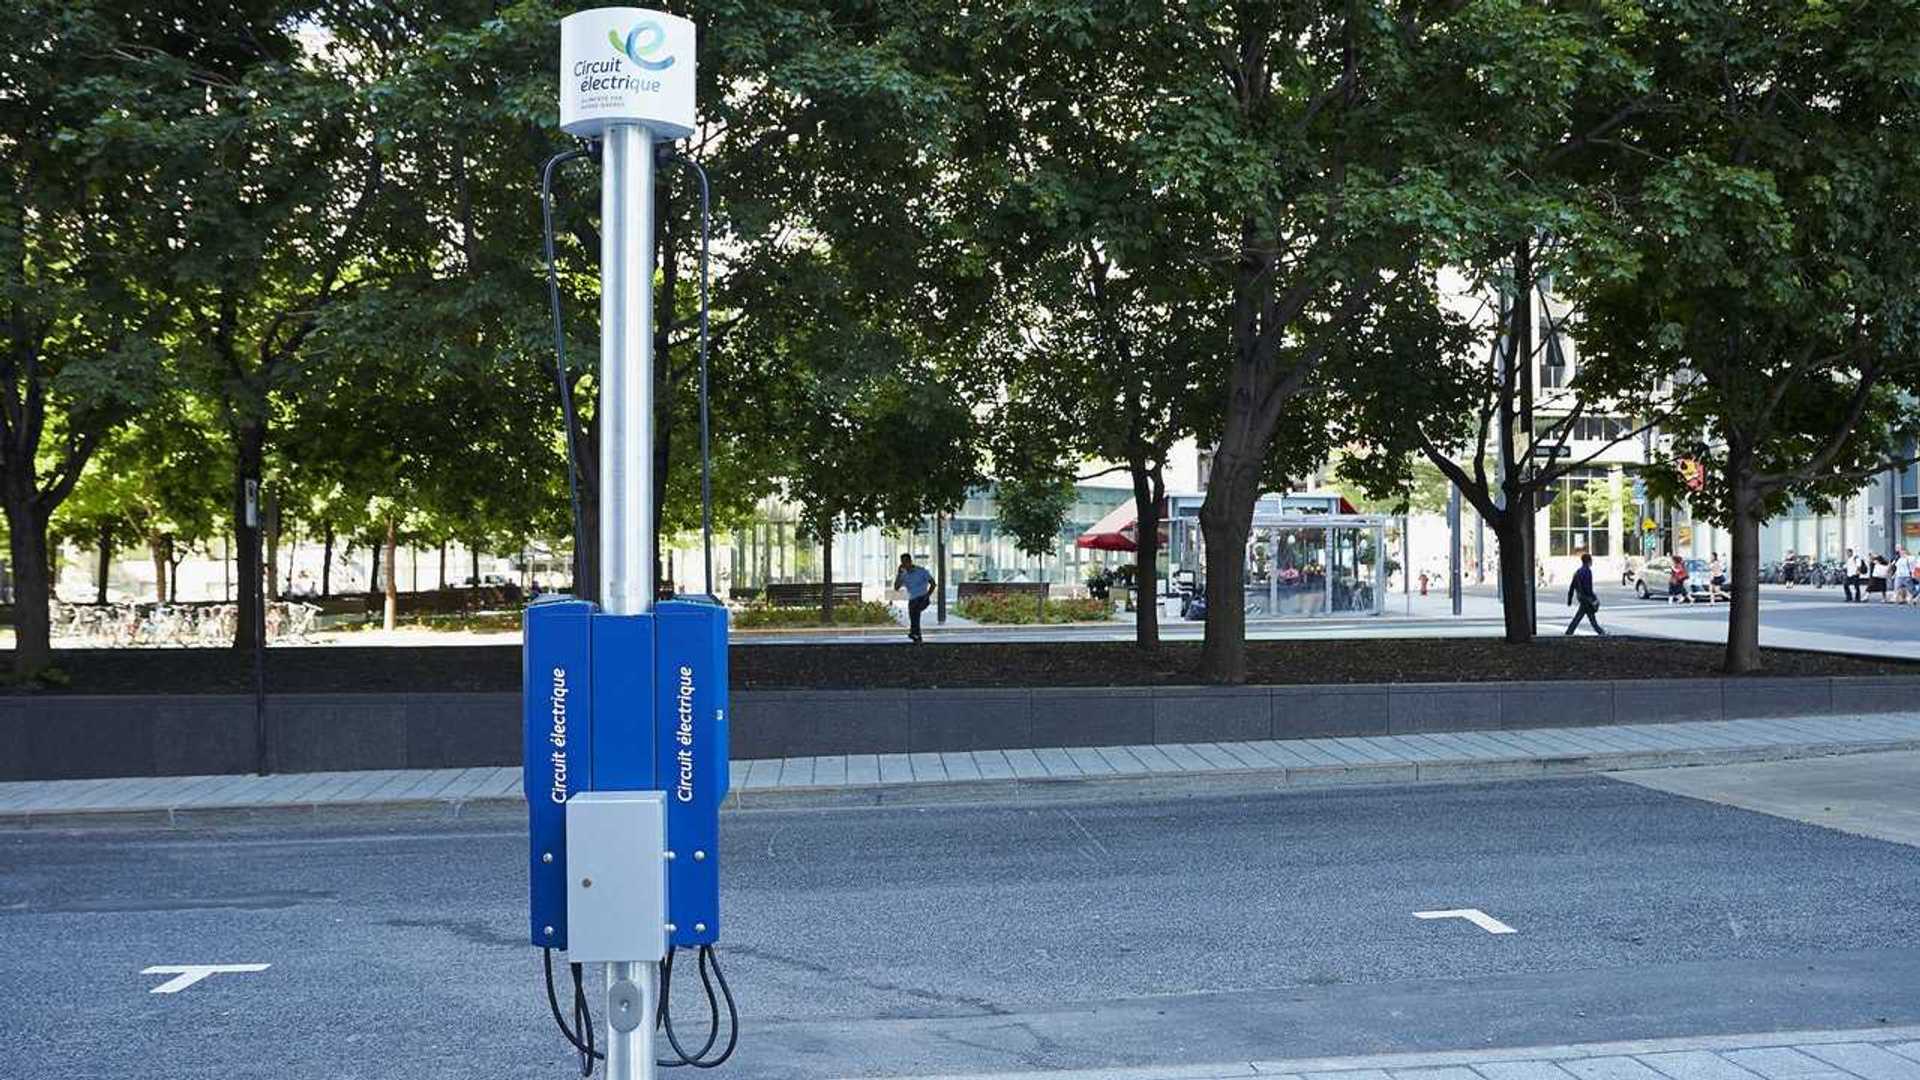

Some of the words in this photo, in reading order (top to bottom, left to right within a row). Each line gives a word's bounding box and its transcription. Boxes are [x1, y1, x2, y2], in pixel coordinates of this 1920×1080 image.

[574, 57, 622, 77] Circuit
[580, 74, 661, 94] électrique
[550, 667, 569, 747] électrique
[676, 666, 696, 746] électrique
[551, 751, 567, 804] Circuit
[677, 749, 693, 803] Circuit
